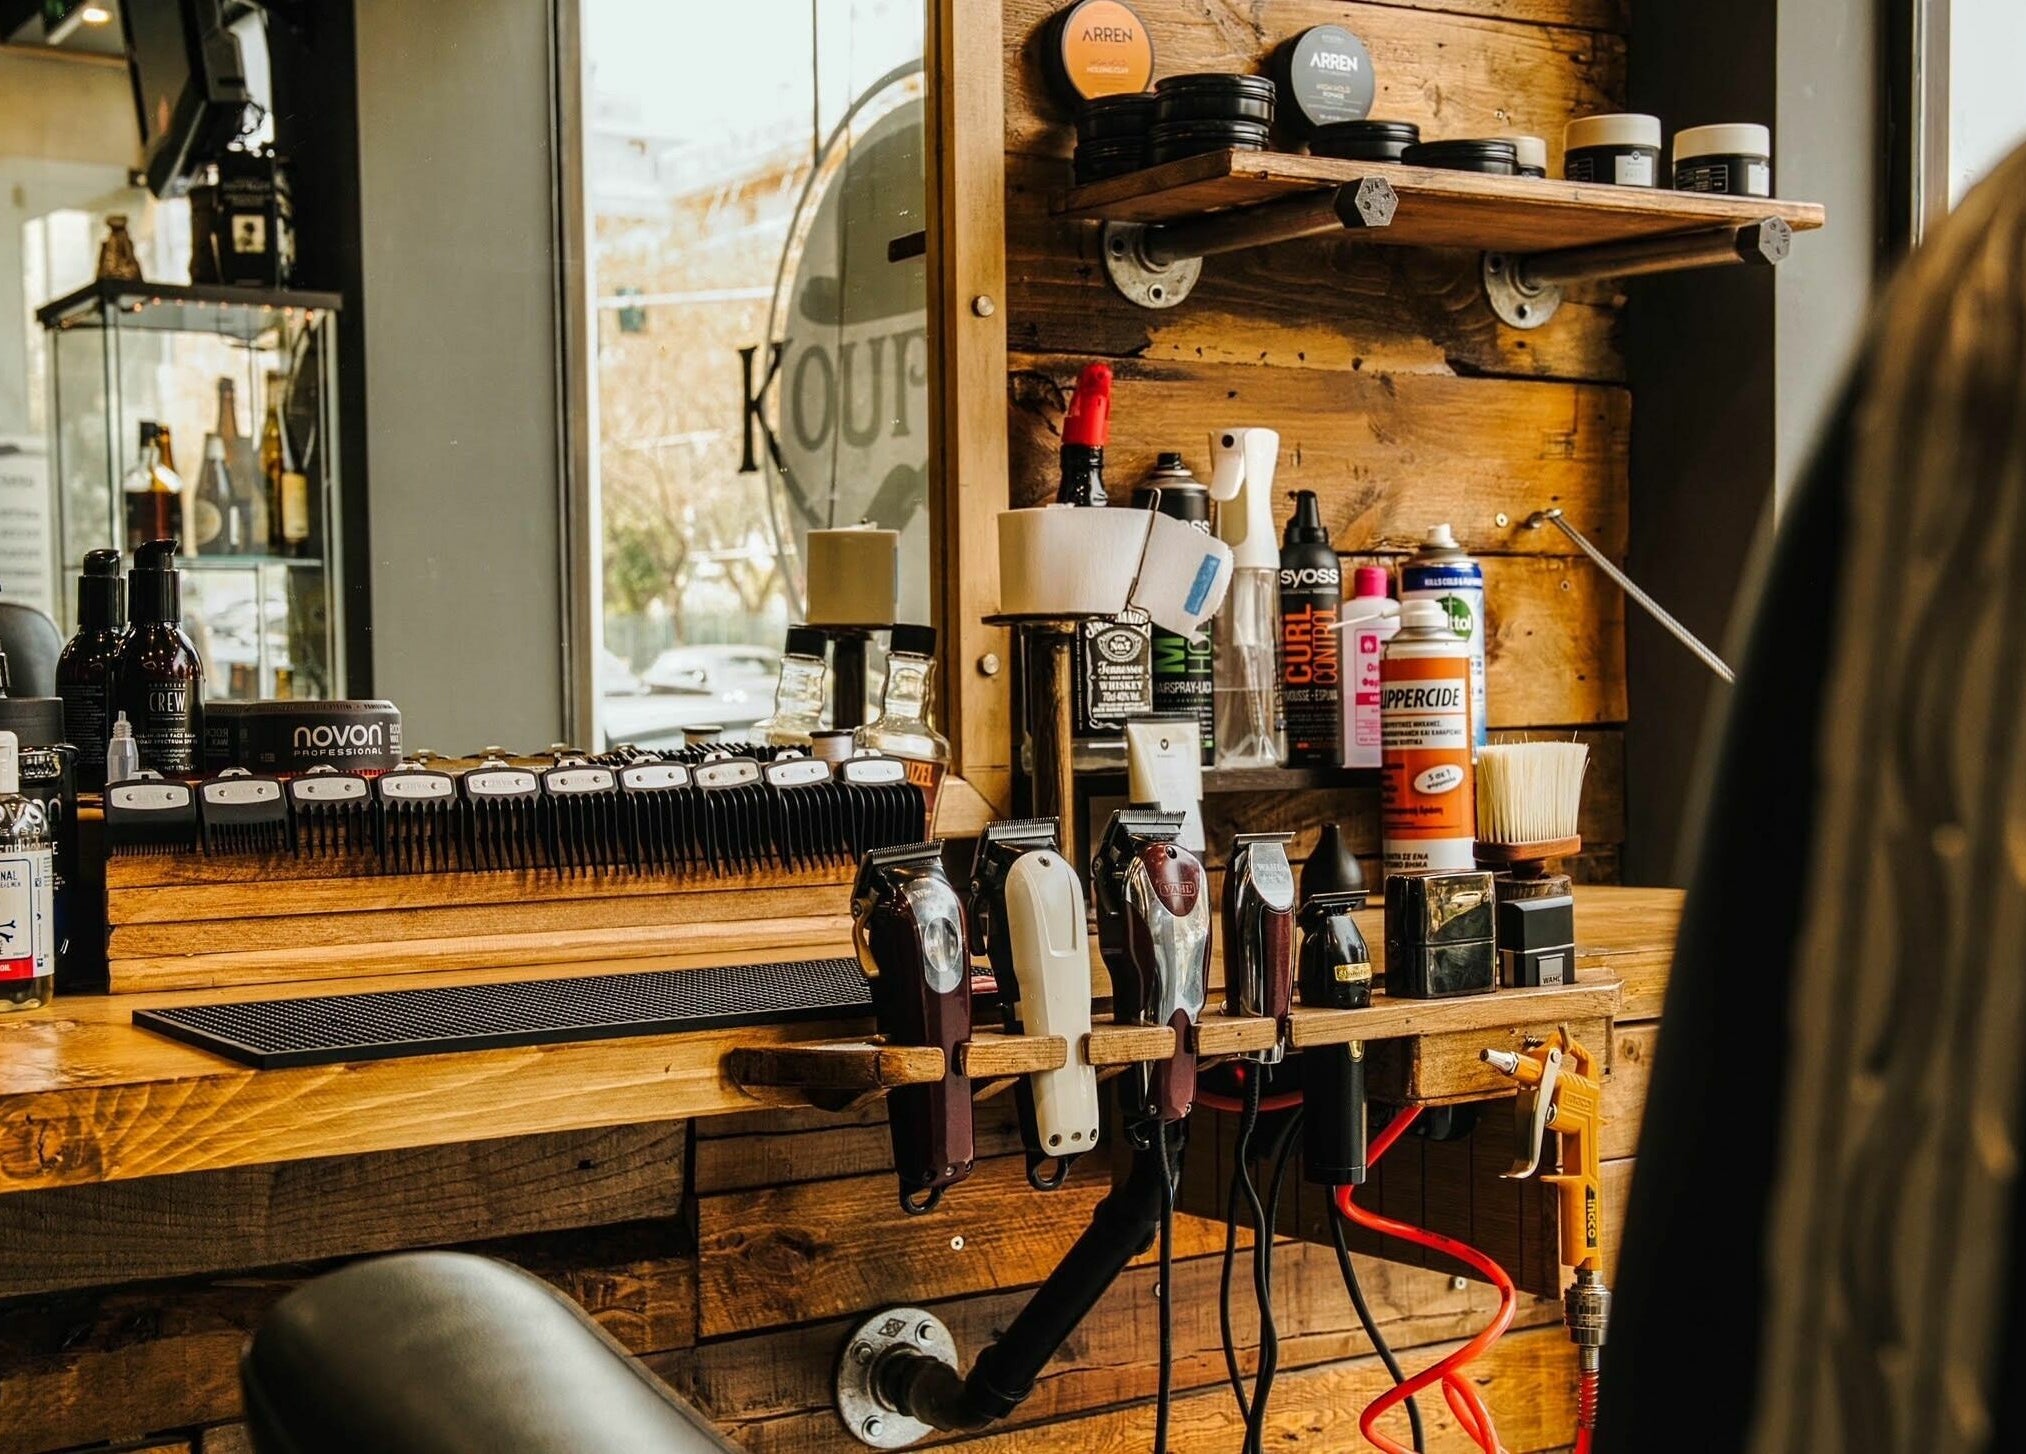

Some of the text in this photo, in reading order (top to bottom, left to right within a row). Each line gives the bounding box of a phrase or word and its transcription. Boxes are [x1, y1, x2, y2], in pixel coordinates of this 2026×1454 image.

[1082, 26, 1133, 43] ARREN
[1309, 51, 1359, 71] ARREN
[1280, 568, 1340, 588] syoss
[1449, 614, 1472, 631] ttol
[1284, 603, 1313, 684] CURL
[1312, 603, 1338, 684] CONTROL
[1097, 661, 1144, 674] Tennessee
[1098, 681, 1144, 691] WHISKEY
[149, 691, 186, 713] CREW
[294, 723, 383, 748] novon
[294, 747, 383, 757] PROFESSIONAL
[1163, 884, 1193, 894] WAHL
